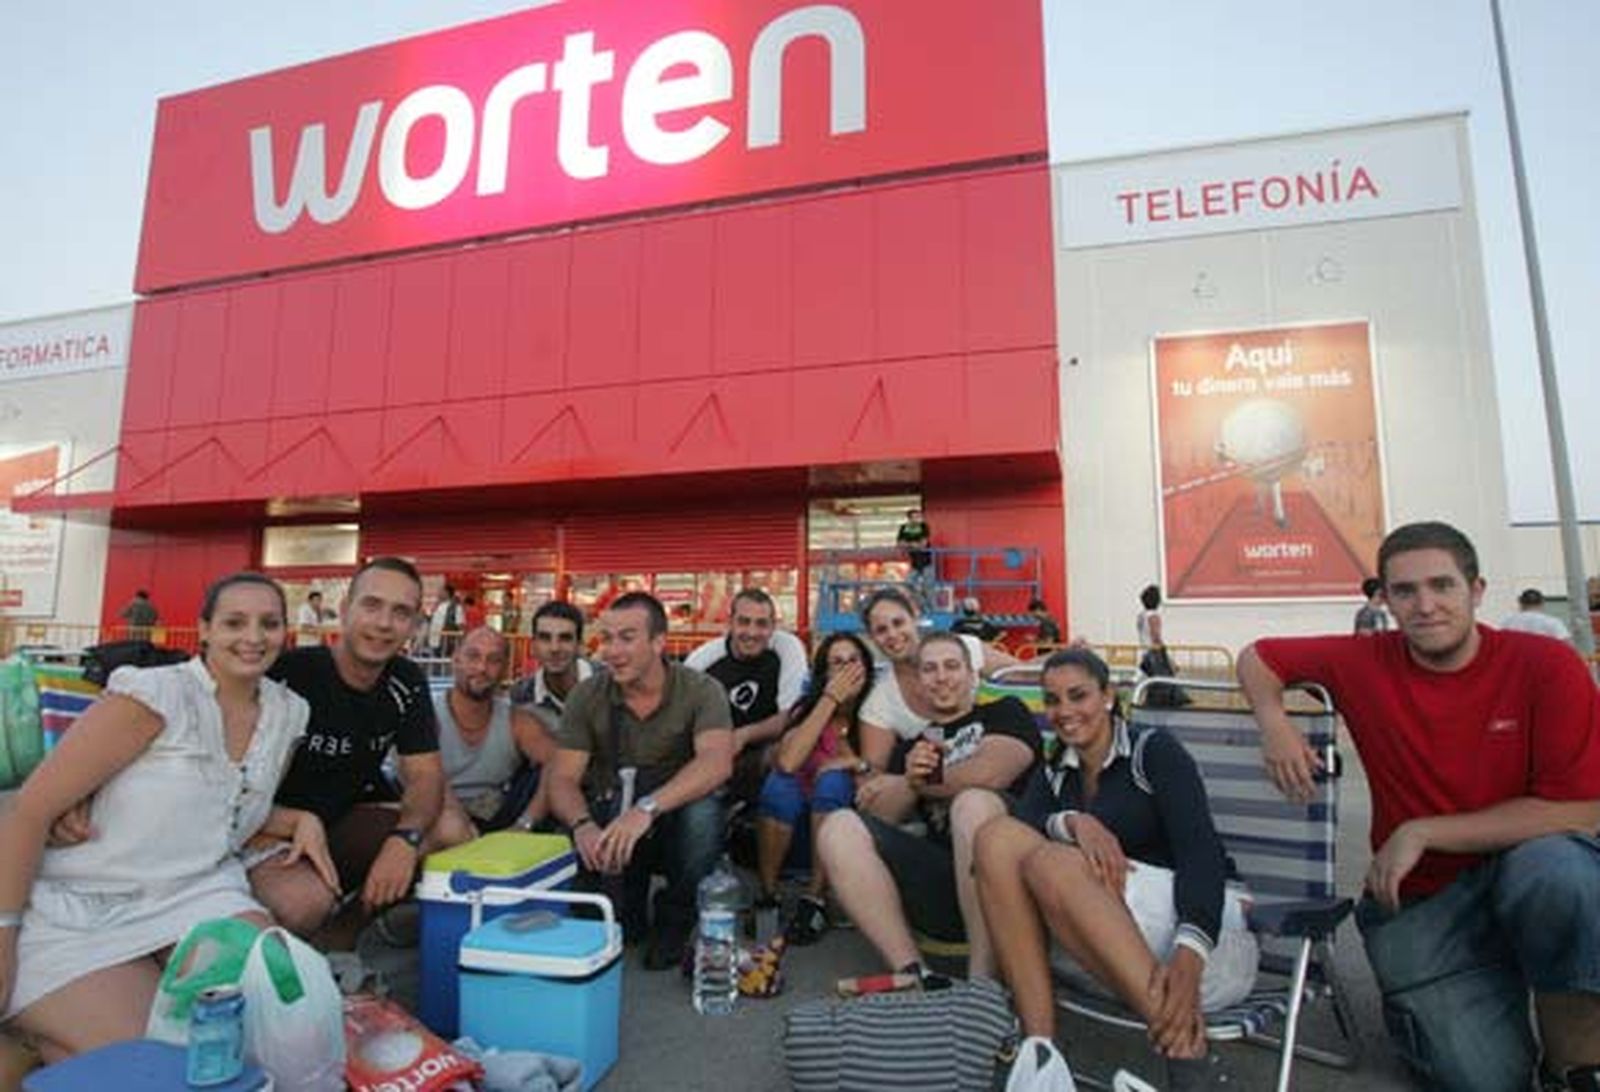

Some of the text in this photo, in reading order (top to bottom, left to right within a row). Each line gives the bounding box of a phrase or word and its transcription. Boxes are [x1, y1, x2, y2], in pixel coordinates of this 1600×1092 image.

[247, 4, 866, 234] worten
[1116, 160, 1379, 224] TELEFONÍA
[1243, 543, 1314, 559] worten
